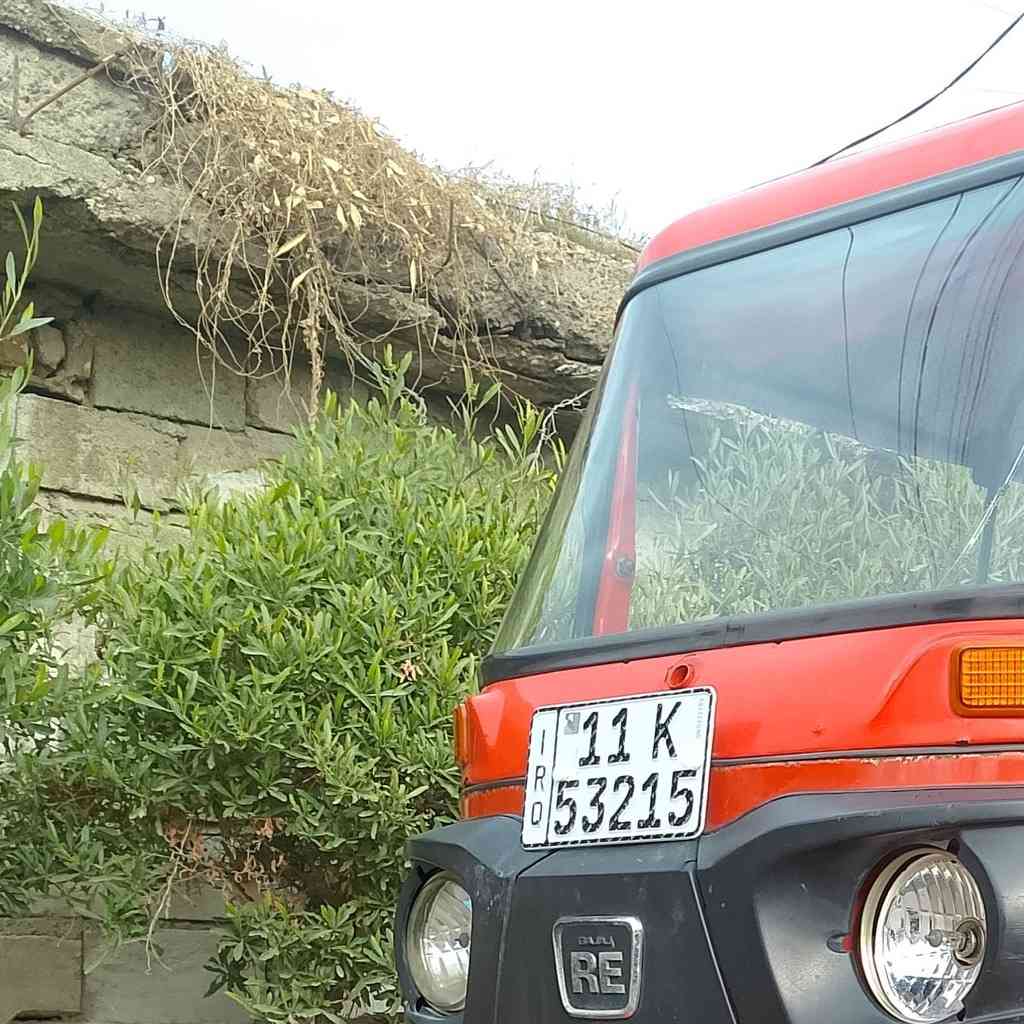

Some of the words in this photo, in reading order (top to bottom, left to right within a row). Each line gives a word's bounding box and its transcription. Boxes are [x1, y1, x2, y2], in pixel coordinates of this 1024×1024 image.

[579, 707, 630, 767] 11
[652, 701, 682, 759] K
[554, 769, 697, 835] 53215
[570, 951, 625, 993] RE
